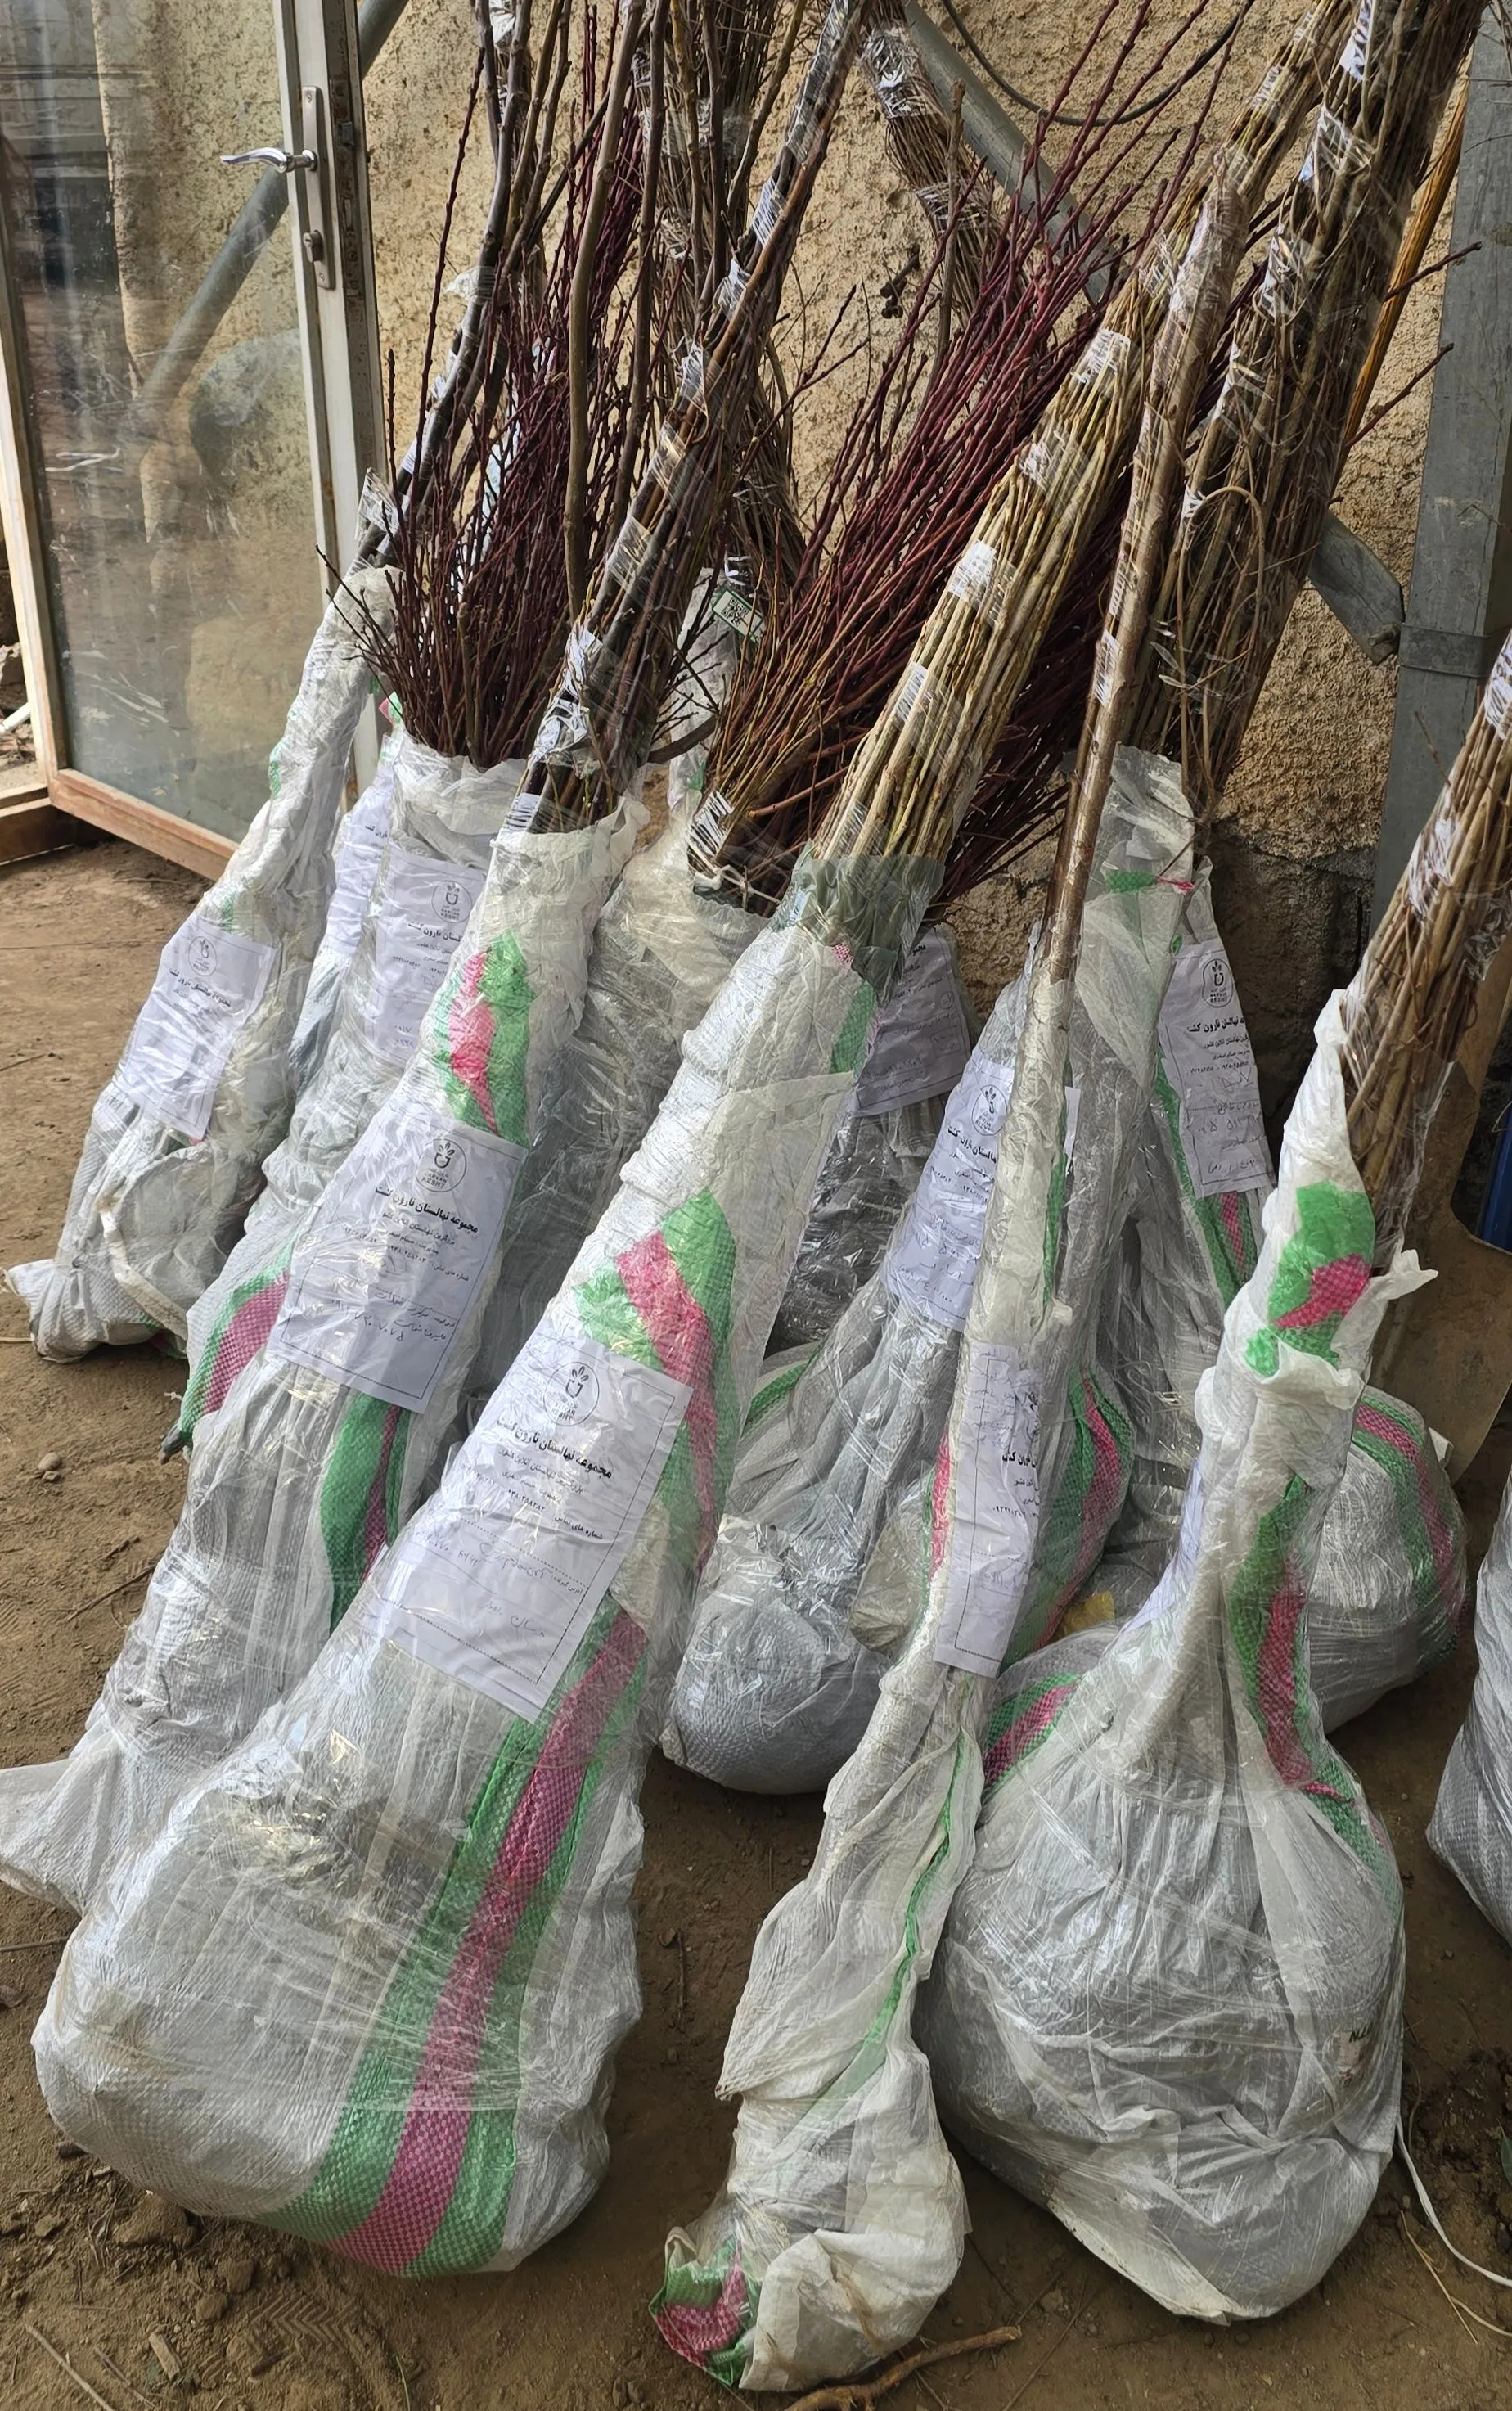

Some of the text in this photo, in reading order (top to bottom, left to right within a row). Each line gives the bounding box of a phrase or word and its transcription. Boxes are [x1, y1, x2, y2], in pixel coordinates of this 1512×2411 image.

[423, 927, 442, 938] نارون
[1203, 1018, 1221, 1033] نارون
[375, 1185, 479, 1234] مجموعه نهالستان نارون کشت
[515, 1427, 541, 1444] نارون
[498, 1447, 515, 1461] کشور
[538, 1439, 575, 1462] نهالستان
[529, 1462, 556, 1480] نهالستان
[576, 1457, 612, 1480] مجموعه
[570, 1523, 584, 1534] های
[585, 1529, 604, 1541] شماره
